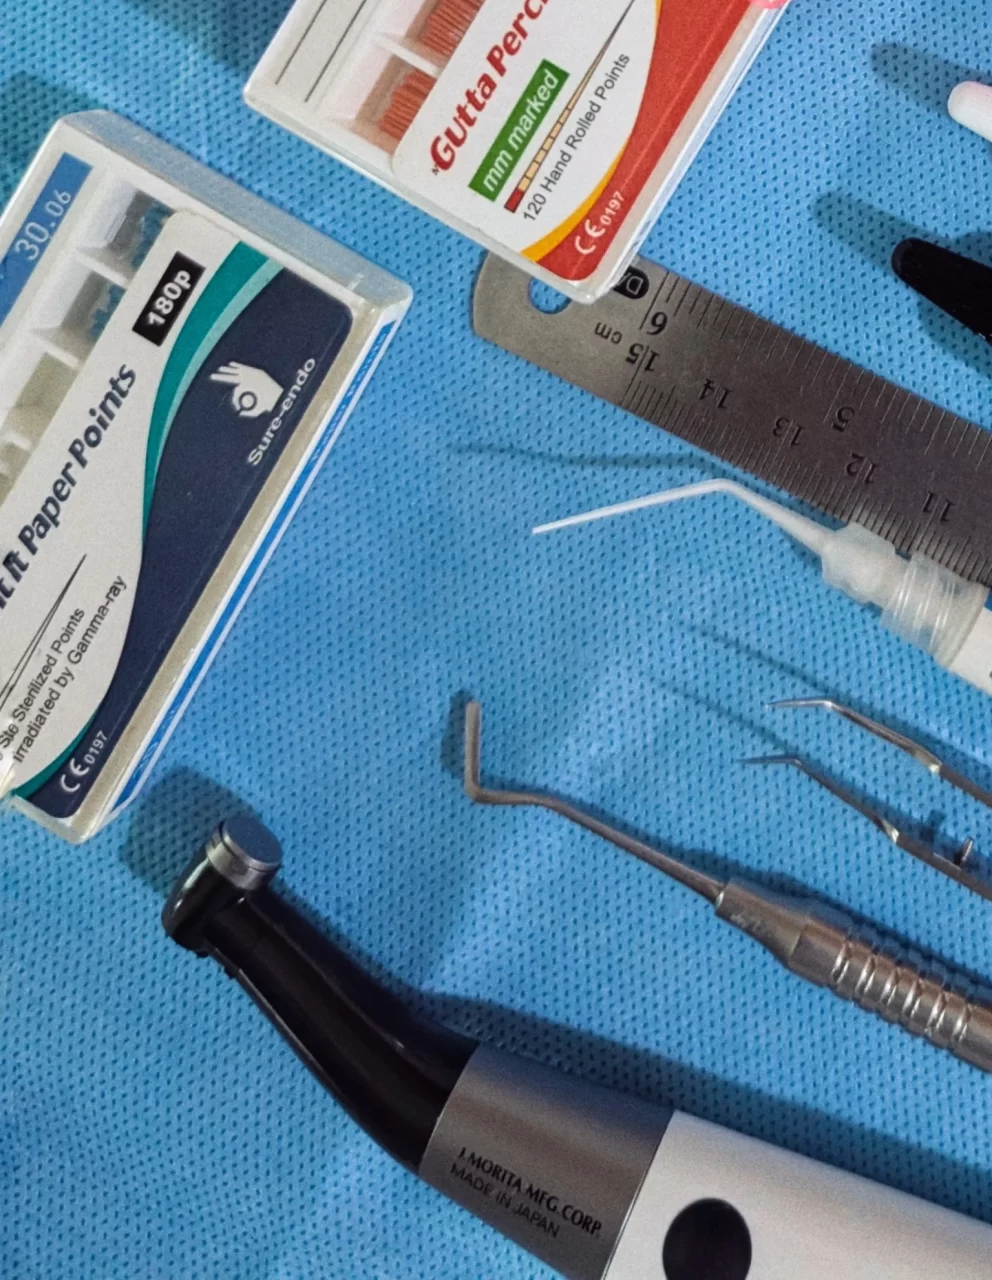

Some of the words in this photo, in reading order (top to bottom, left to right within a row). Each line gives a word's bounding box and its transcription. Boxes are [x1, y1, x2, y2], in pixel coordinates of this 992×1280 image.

[430, 73, 496, 170] Gutta
[483, 149, 513, 191] mm
[507, 69, 558, 150] marked
[522, 192, 547, 220] 120
[539, 149, 572, 192] Hand
[564, 100, 601, 150] Rolled
[593, 54, 630, 100] Points
[14, 190, 71, 260] 30.06
[599, 190, 623, 225] 0197
[147, 270, 191, 324] 180p
[593, 322, 623, 345] cm
[649, 311, 668, 336] 6
[625, 340, 659, 372] 15
[247, 358, 315, 465] Sure-endo
[697, 379, 730, 409] 14
[772, 416, 803, 446] 13
[829, 405, 853, 434] 5
[17, 462, 78, 555] Paper
[68, 365, 135, 467] Points
[843, 453, 878, 483] 12
[919, 492, 957, 523] 11
[52, 666, 75, 689] by
[66, 576, 126, 665] Gamma-ray
[11, 654, 57, 722] Sterilized
[50, 608, 85, 653] Points
[83, 730, 110, 764] 0197
[450, 1163, 496, 1196] MADE
[495, 1192, 512, 1209] IN
[512, 1202, 560, 1238] JAPAN
